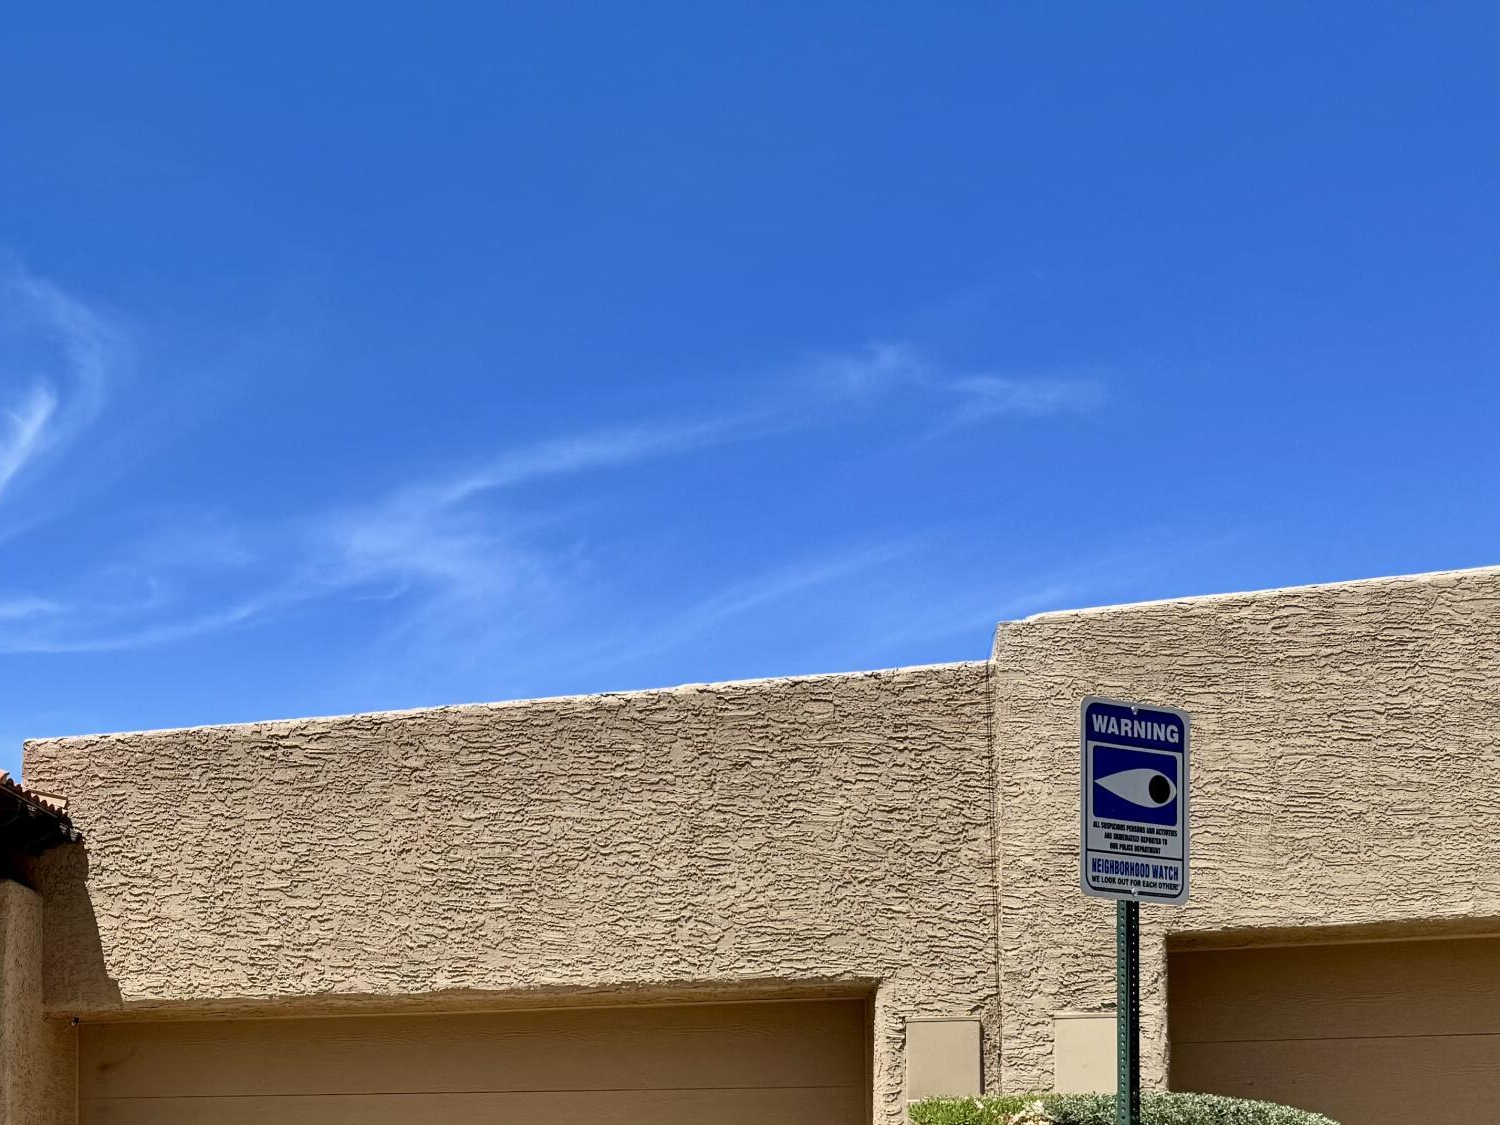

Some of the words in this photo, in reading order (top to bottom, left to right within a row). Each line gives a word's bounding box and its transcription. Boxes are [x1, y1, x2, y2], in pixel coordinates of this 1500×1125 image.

[1092, 713, 1179, 743] WARNING
[1119, 843, 1133, 851] POLICE
[1092, 858, 1149, 878] NEIGHBORHOOD
[1151, 864, 1178, 881] WATCH
[1092, 875, 1100, 883] WE
[1101, 876, 1116, 884] LOOK
[1117, 878, 1129, 886] OUT
[1130, 879, 1141, 887] FOR
[1143, 881, 1157, 889] EACH
